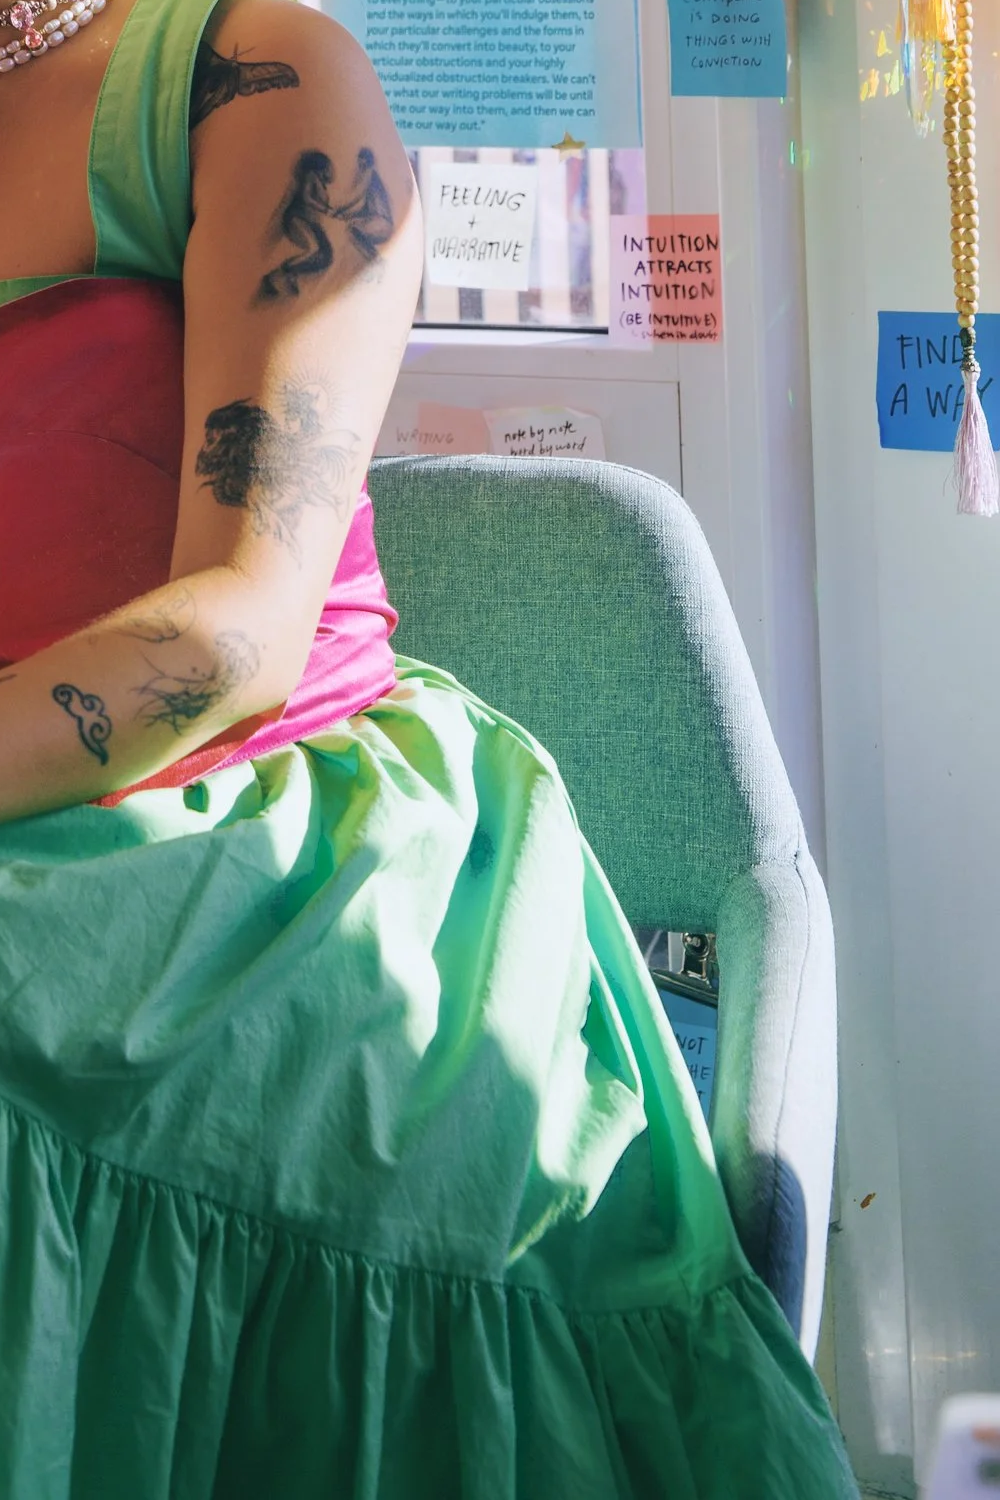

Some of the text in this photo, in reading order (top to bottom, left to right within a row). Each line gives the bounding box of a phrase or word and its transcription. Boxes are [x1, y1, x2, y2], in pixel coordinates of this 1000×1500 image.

[366, 9, 595, 22] and the ways which indulge to
[711, 12, 760, 24] DOING
[366, 24, 573, 38] your particular challenges and the forms
[366, 41, 576, 54] which convert into your
[685, 33, 772, 48] THINGS WITH
[416, 56, 565, 70] obstructions and your highly
[691, 56, 763, 69] CONVICTION
[436, 71, 568, 84] obstruction We
[394, 87, 419, 98] what
[421, 90, 439, 99] our
[441, 88, 480, 101] writing
[482, 90, 533, 102] problems
[535, 90, 553, 100] will
[555, 90, 567, 100] be
[570, 90, 593, 100] until
[428, 104, 595, 117] way into and then can
[435, 121, 457, 133] way
[440, 184, 527, 212] FEELING
[432, 236, 525, 263] NARRATIVE
[623, 233, 719, 254] INTUITION
[634, 259, 713, 277] ATTRACTS
[621, 279, 716, 302] INTUITION
[619, 311, 718, 330] (BE INTUITIVE)
[896, 334, 967, 370] FIND
[890, 382, 909, 417] A
[396, 429, 455, 446] WRITING
[504, 420, 576, 443] note by note
[539, 441, 553, 456] by
[555, 436, 587, 452] word
